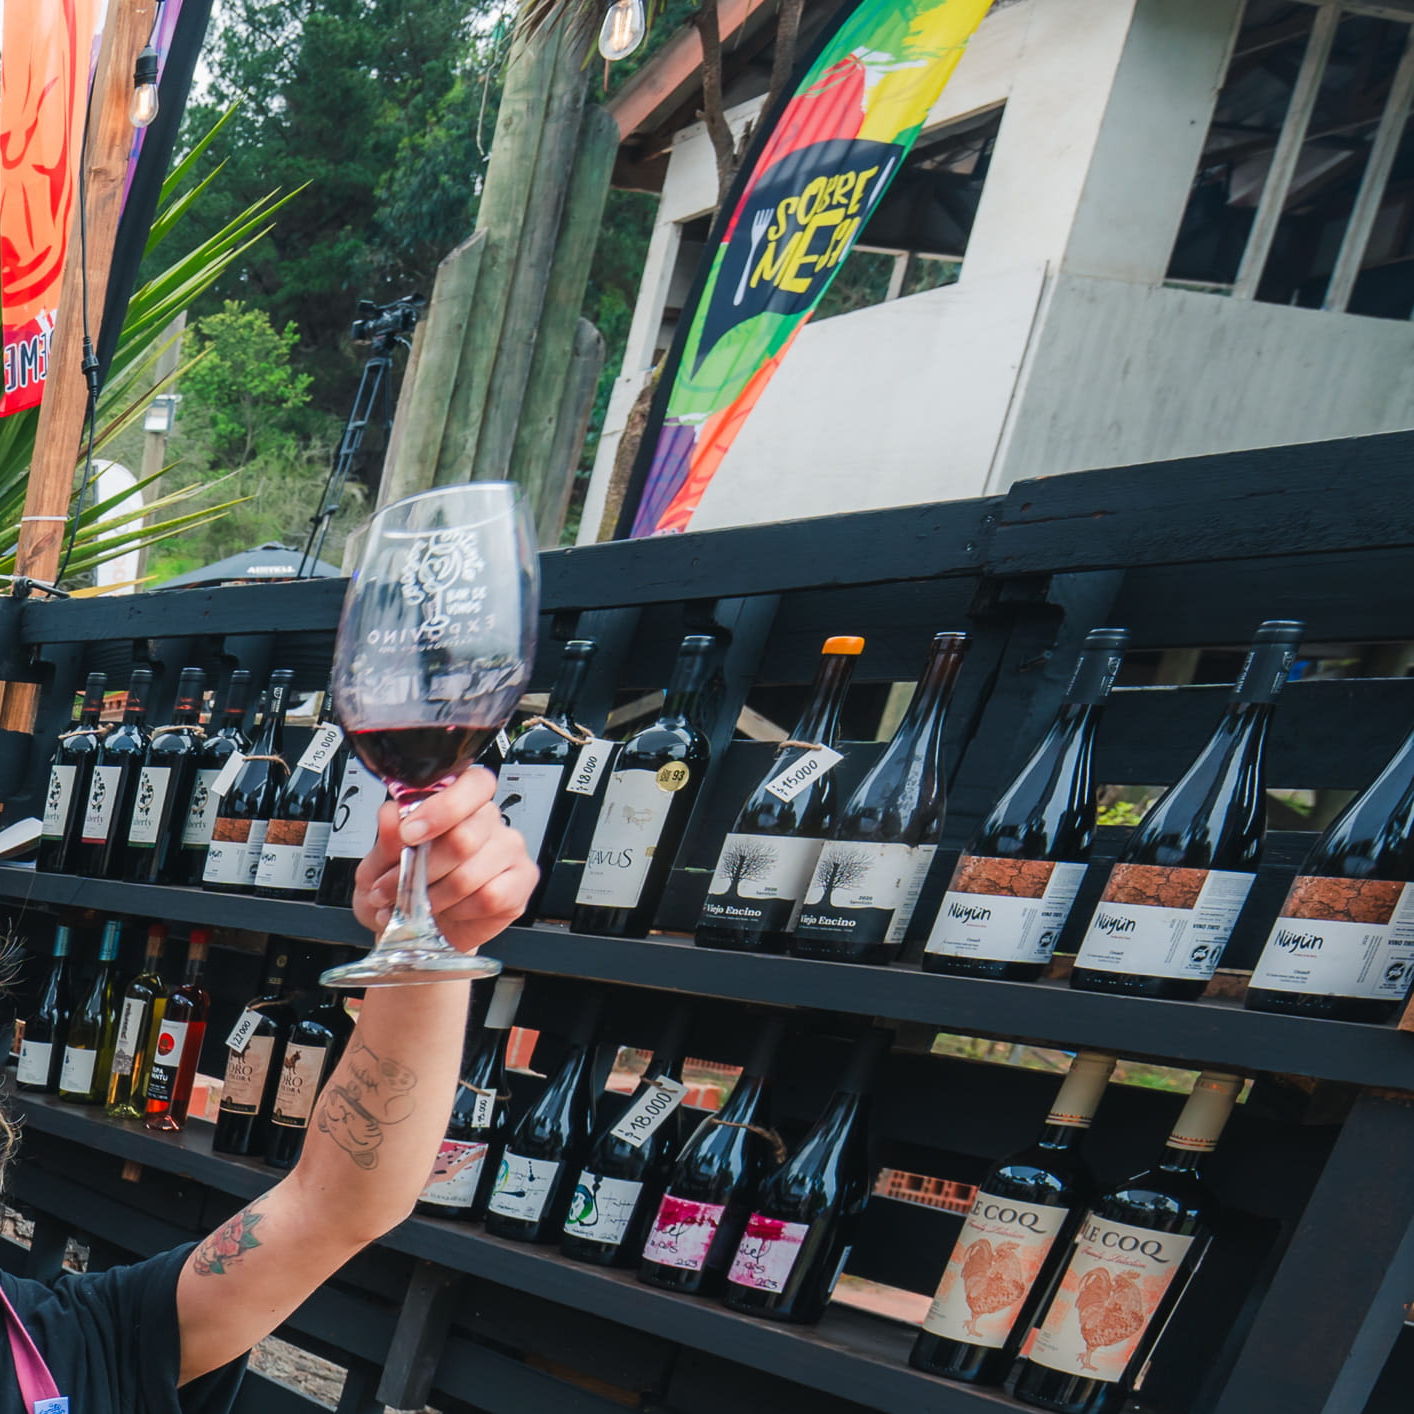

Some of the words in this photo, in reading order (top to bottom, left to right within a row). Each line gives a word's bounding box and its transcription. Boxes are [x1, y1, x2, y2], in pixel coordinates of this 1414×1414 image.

[768, 165, 879, 241] SOBRE
[750, 210, 860, 293] MESA
[671, 769, 685, 781] 93
[726, 905, 762, 917] Encino
[818, 916, 857, 927] Encino
[984, 1204, 1047, 1234] COQ
[1102, 1231, 1170, 1263] COQ
